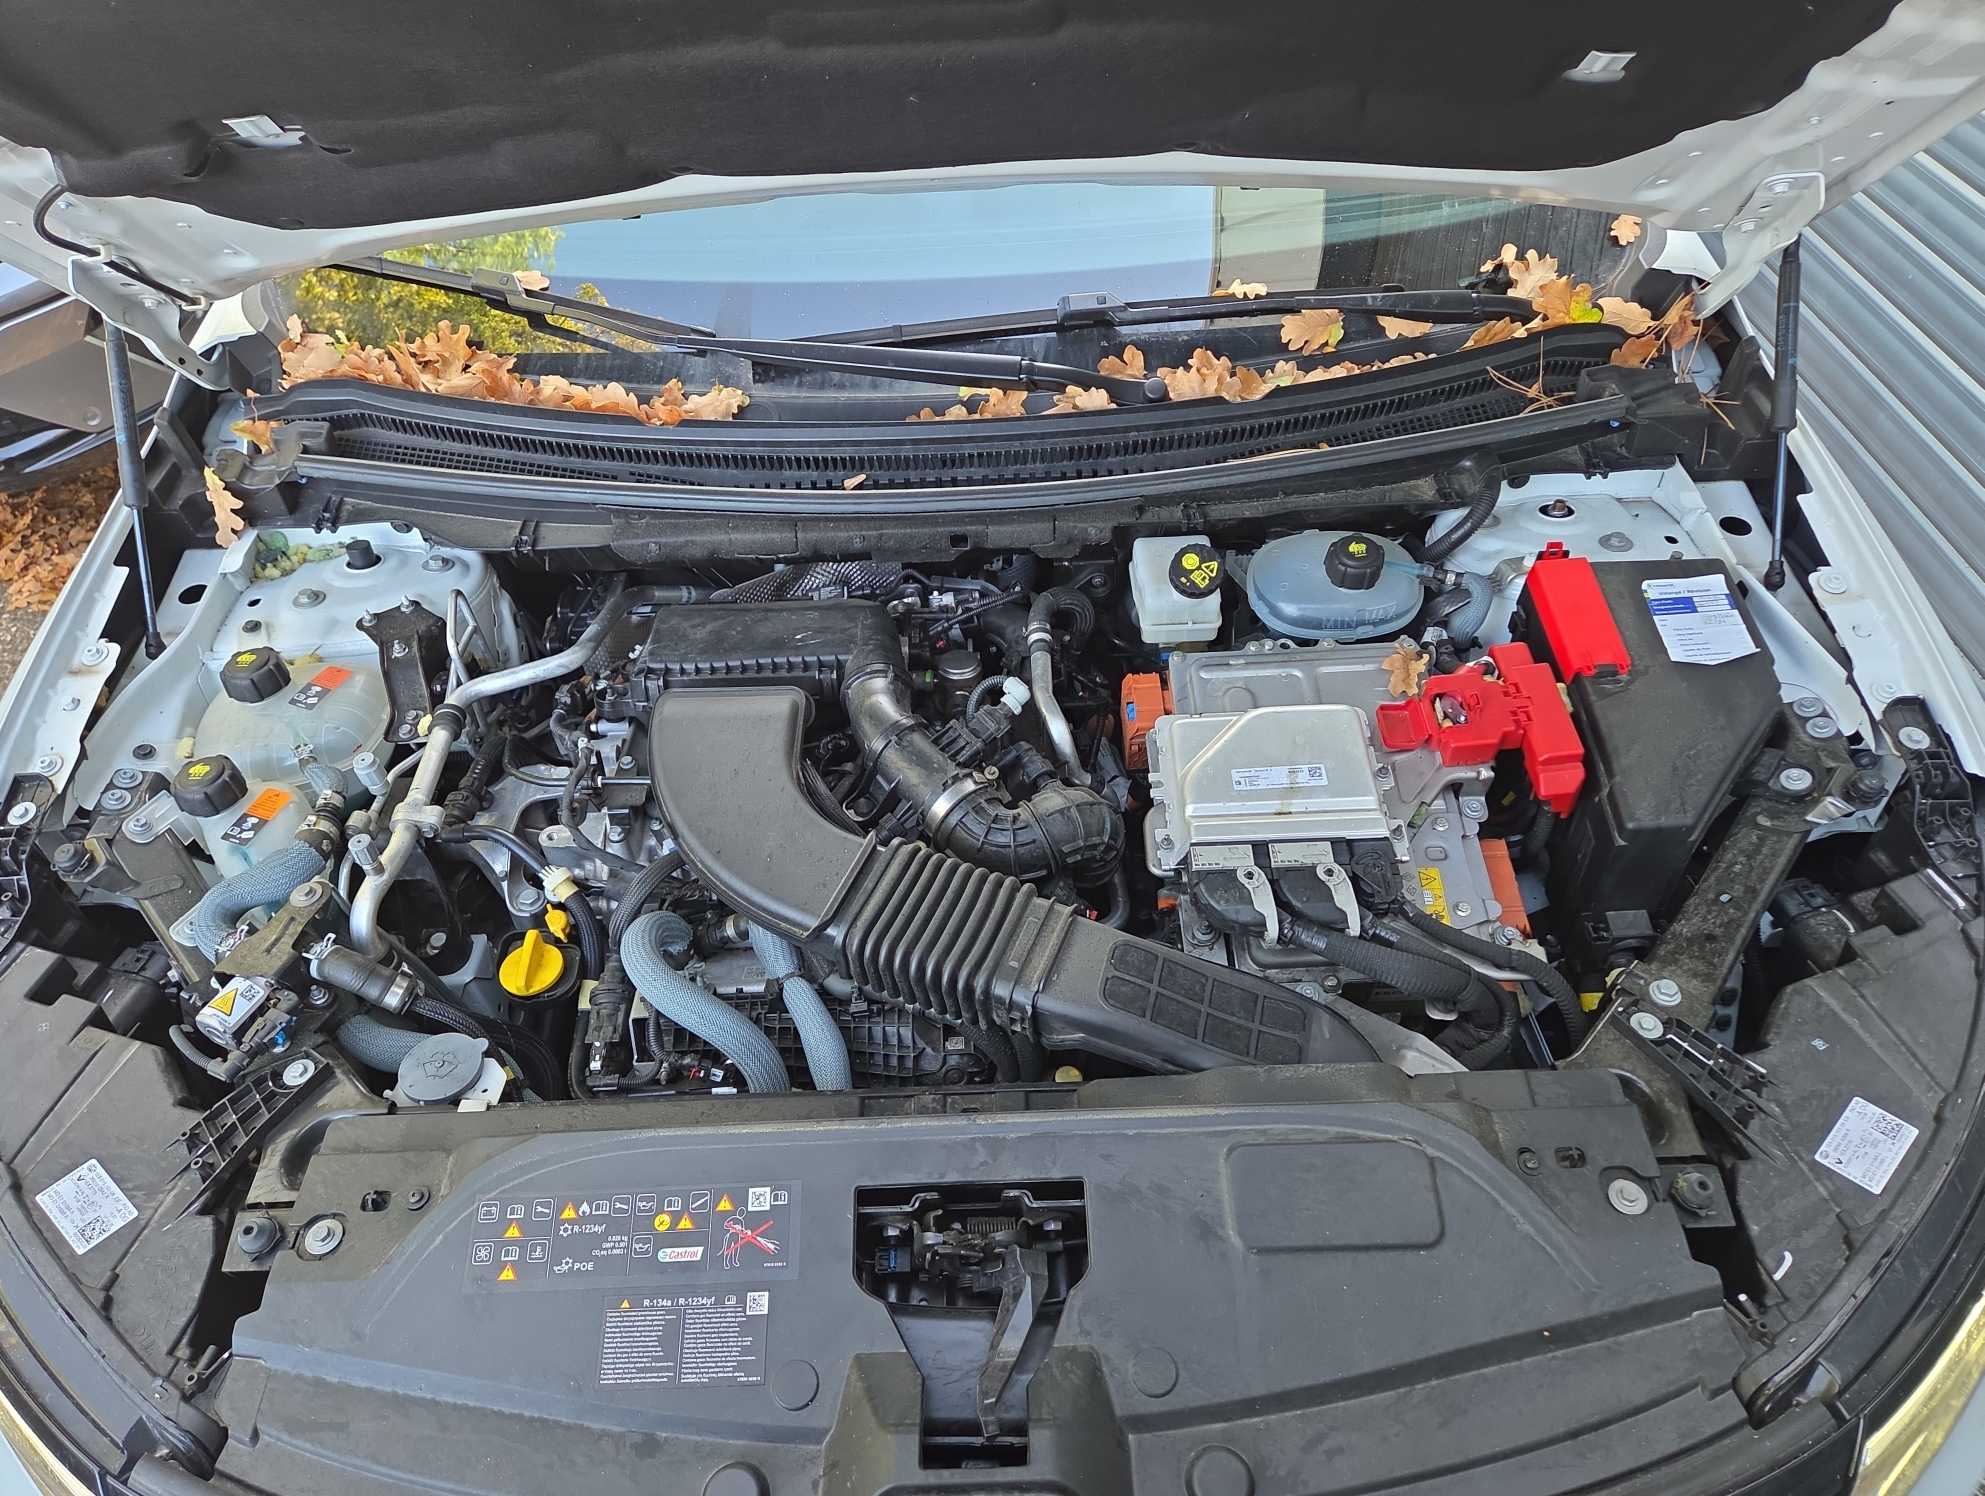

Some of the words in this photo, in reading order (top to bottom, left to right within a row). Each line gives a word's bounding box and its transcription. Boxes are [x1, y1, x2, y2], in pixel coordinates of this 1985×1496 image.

[1322, 616, 1357, 629] MIN
[573, 1223, 607, 1235] R-1234yf
[668, 1248, 699, 1260] Castrol
[573, 1261, 595, 1271] POE
[643, 1298, 672, 1308] R-134a
[678, 1296, 716, 1308] R-1234yf
